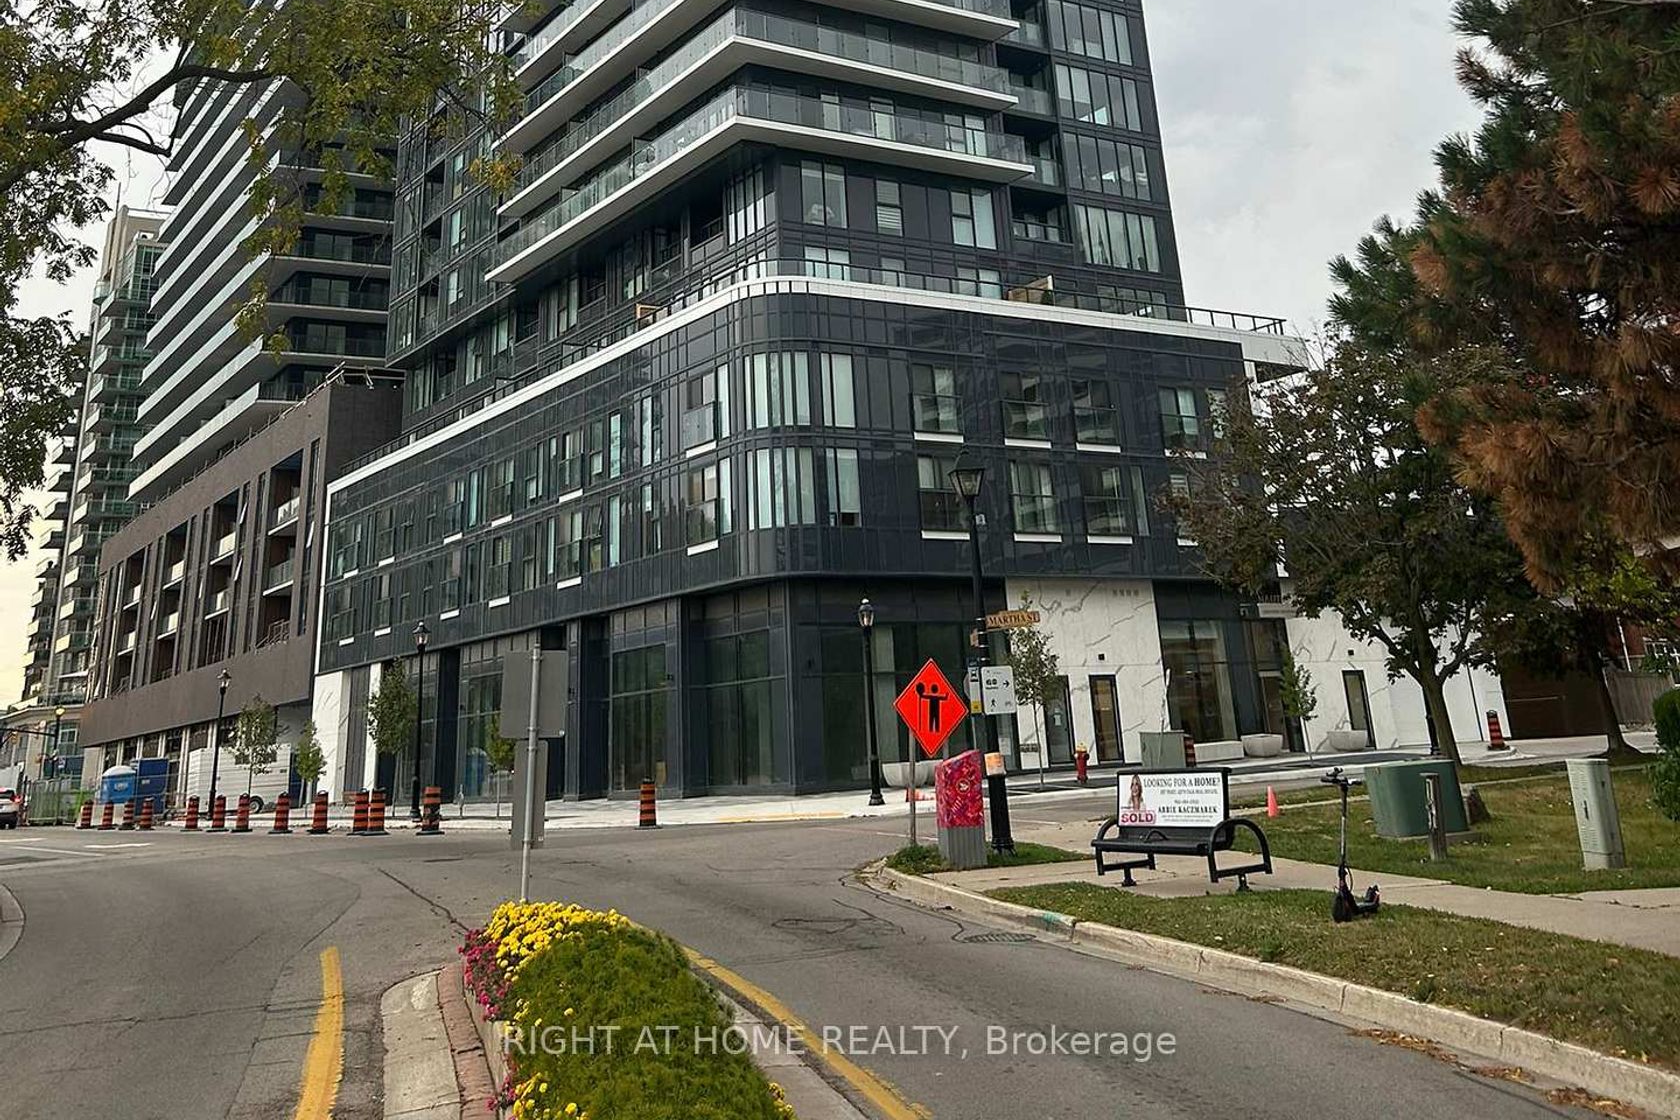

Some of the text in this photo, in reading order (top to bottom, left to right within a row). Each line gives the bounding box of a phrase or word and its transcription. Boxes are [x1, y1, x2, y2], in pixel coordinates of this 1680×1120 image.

[988, 613, 1026, 625] MARTHA
[1143, 778, 1172, 788] LOOKING
[1173, 778, 1187, 787] FOR
[1194, 777, 1220, 787] HOME?
[1121, 813, 1153, 823] SOLD
